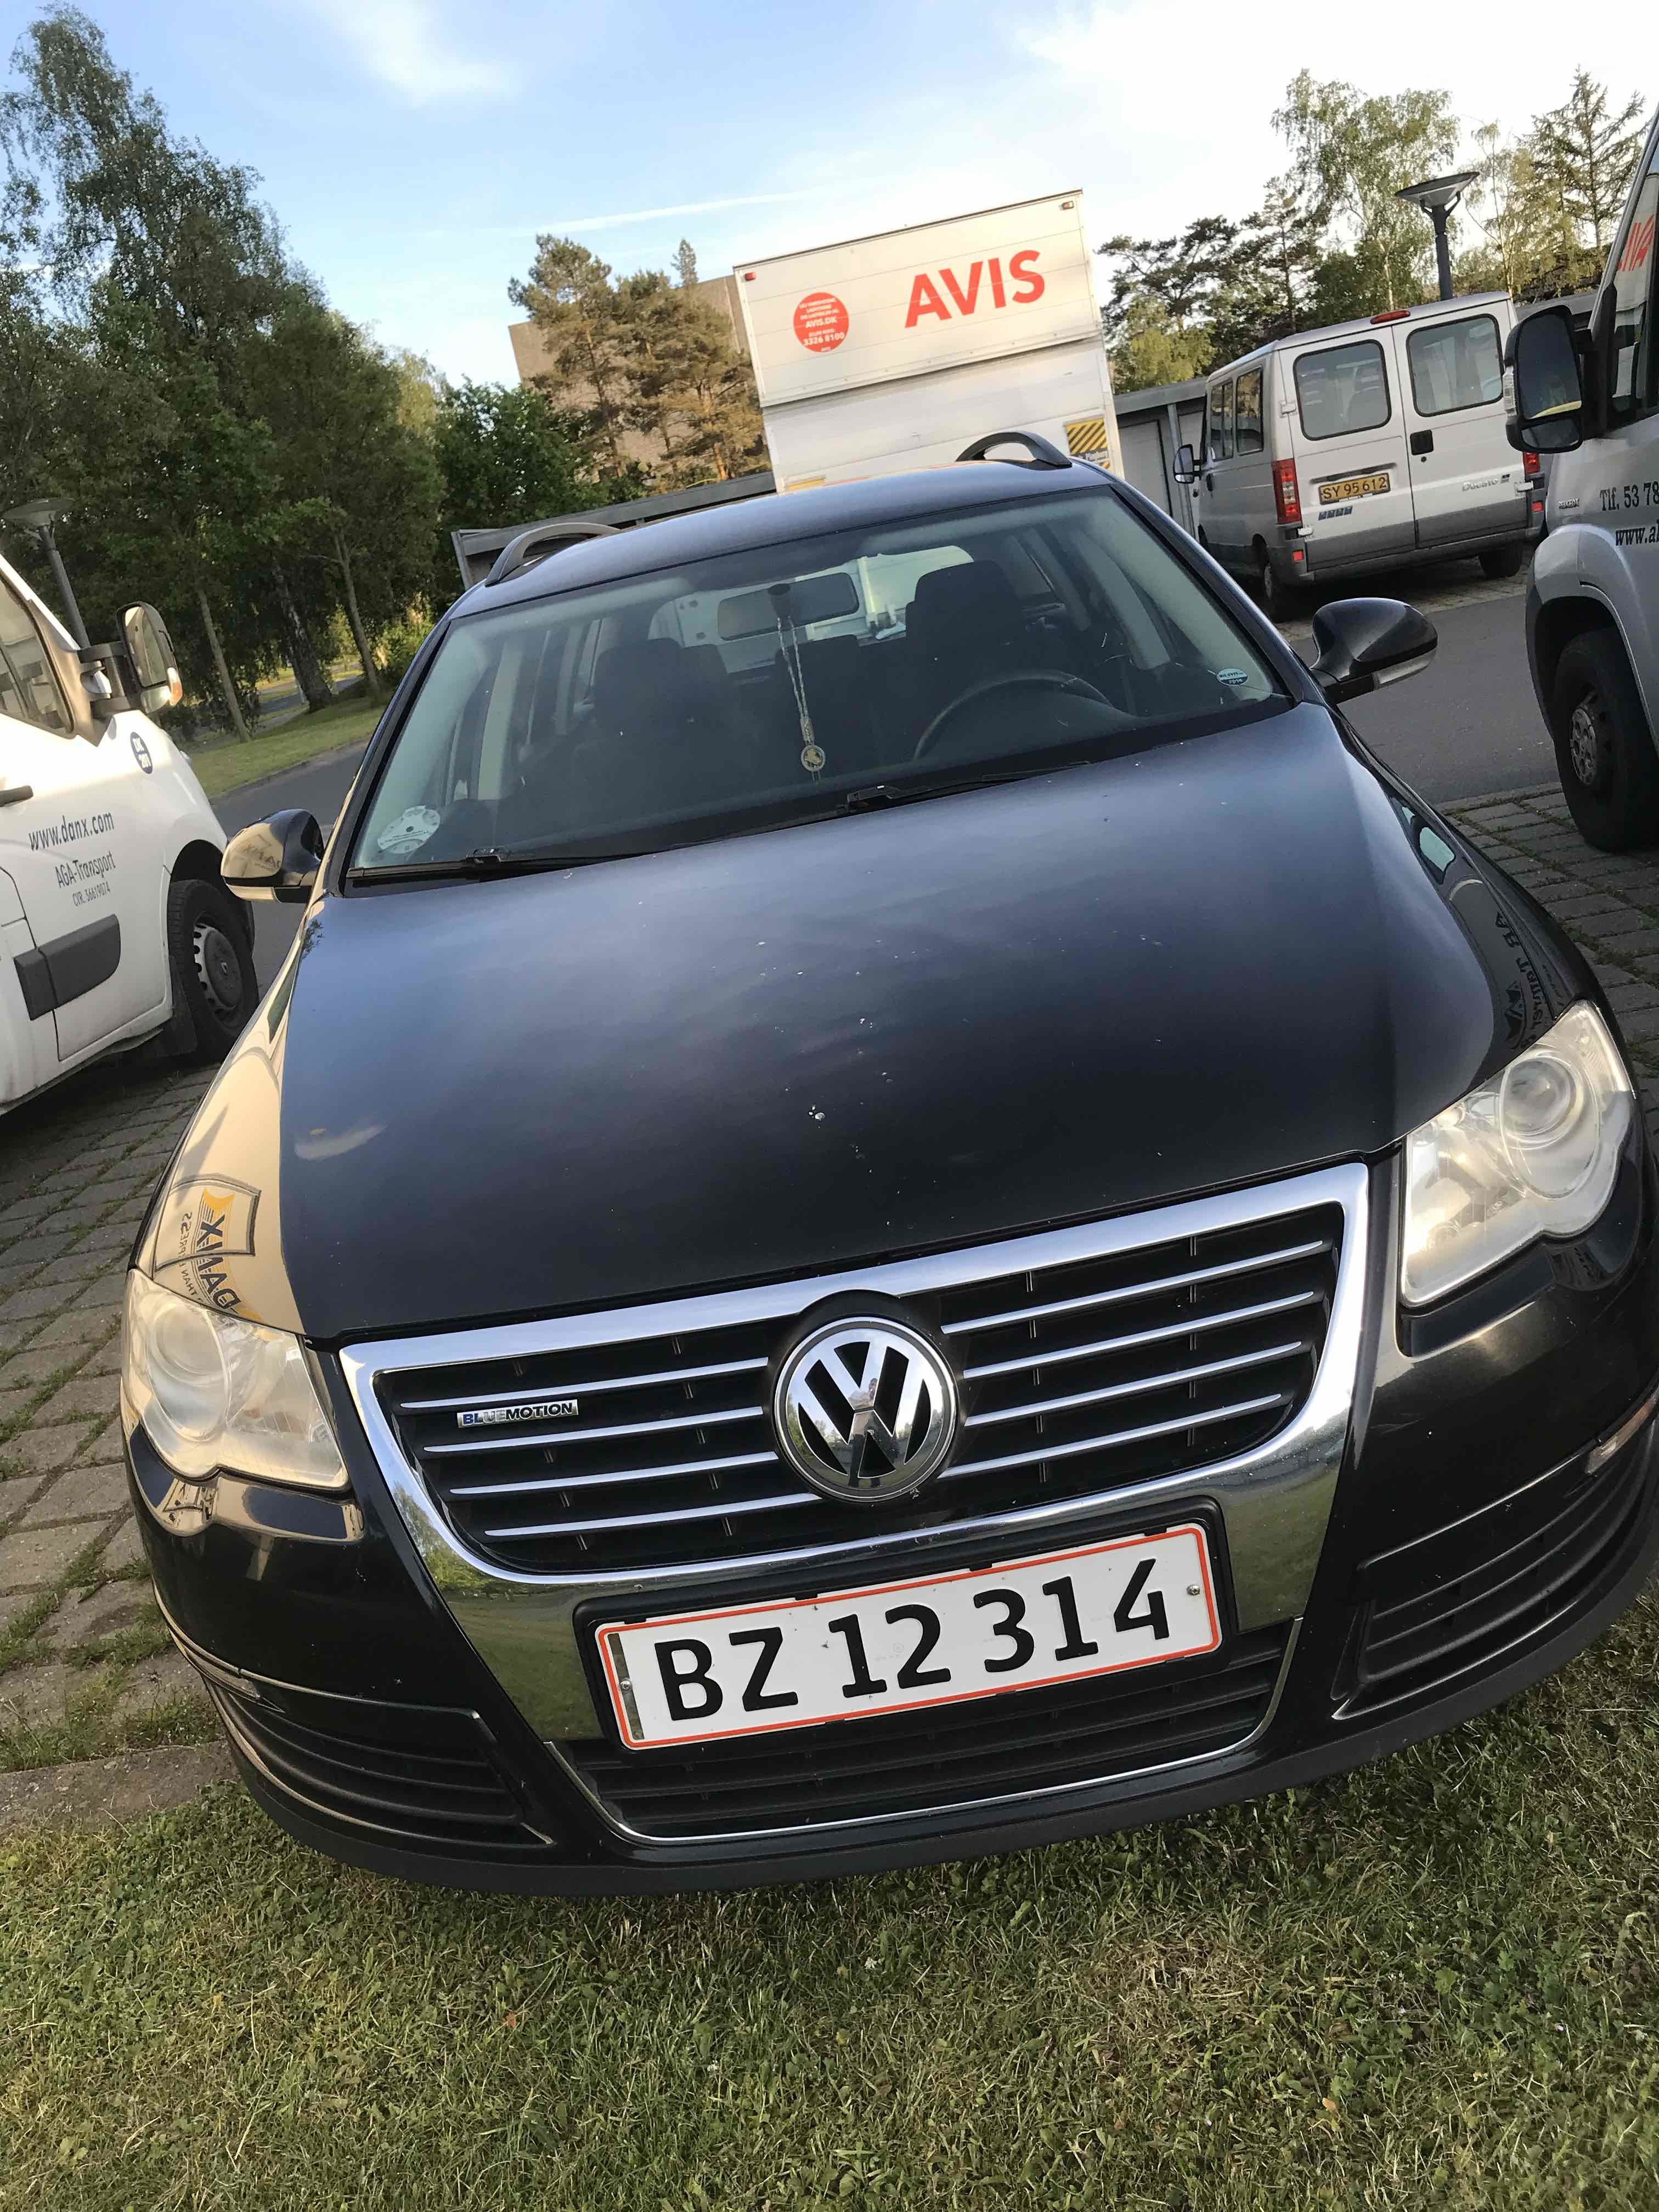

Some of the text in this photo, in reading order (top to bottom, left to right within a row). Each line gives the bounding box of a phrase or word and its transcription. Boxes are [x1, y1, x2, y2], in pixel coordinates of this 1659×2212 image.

[905, 250, 1045, 328] AVIS
[803, 336, 823, 346] 3326
[825, 332, 845, 342] 8100
[1323, 486, 1340, 499] SY
[1344, 483, 1359, 495] 95
[1362, 477, 1386, 492] 612
[1599, 481, 1659, 511] Tlf. 53 78
[132, 737, 144, 751] DK
[138, 753, 151, 768] 201
[29, 812, 114, 851] www.danx.com
[55, 850, 116, 889] AGA-Transport
[462, 1402, 573, 1426] BLUEMOTION
[654, 1558, 1170, 1722] BZ 12 314
